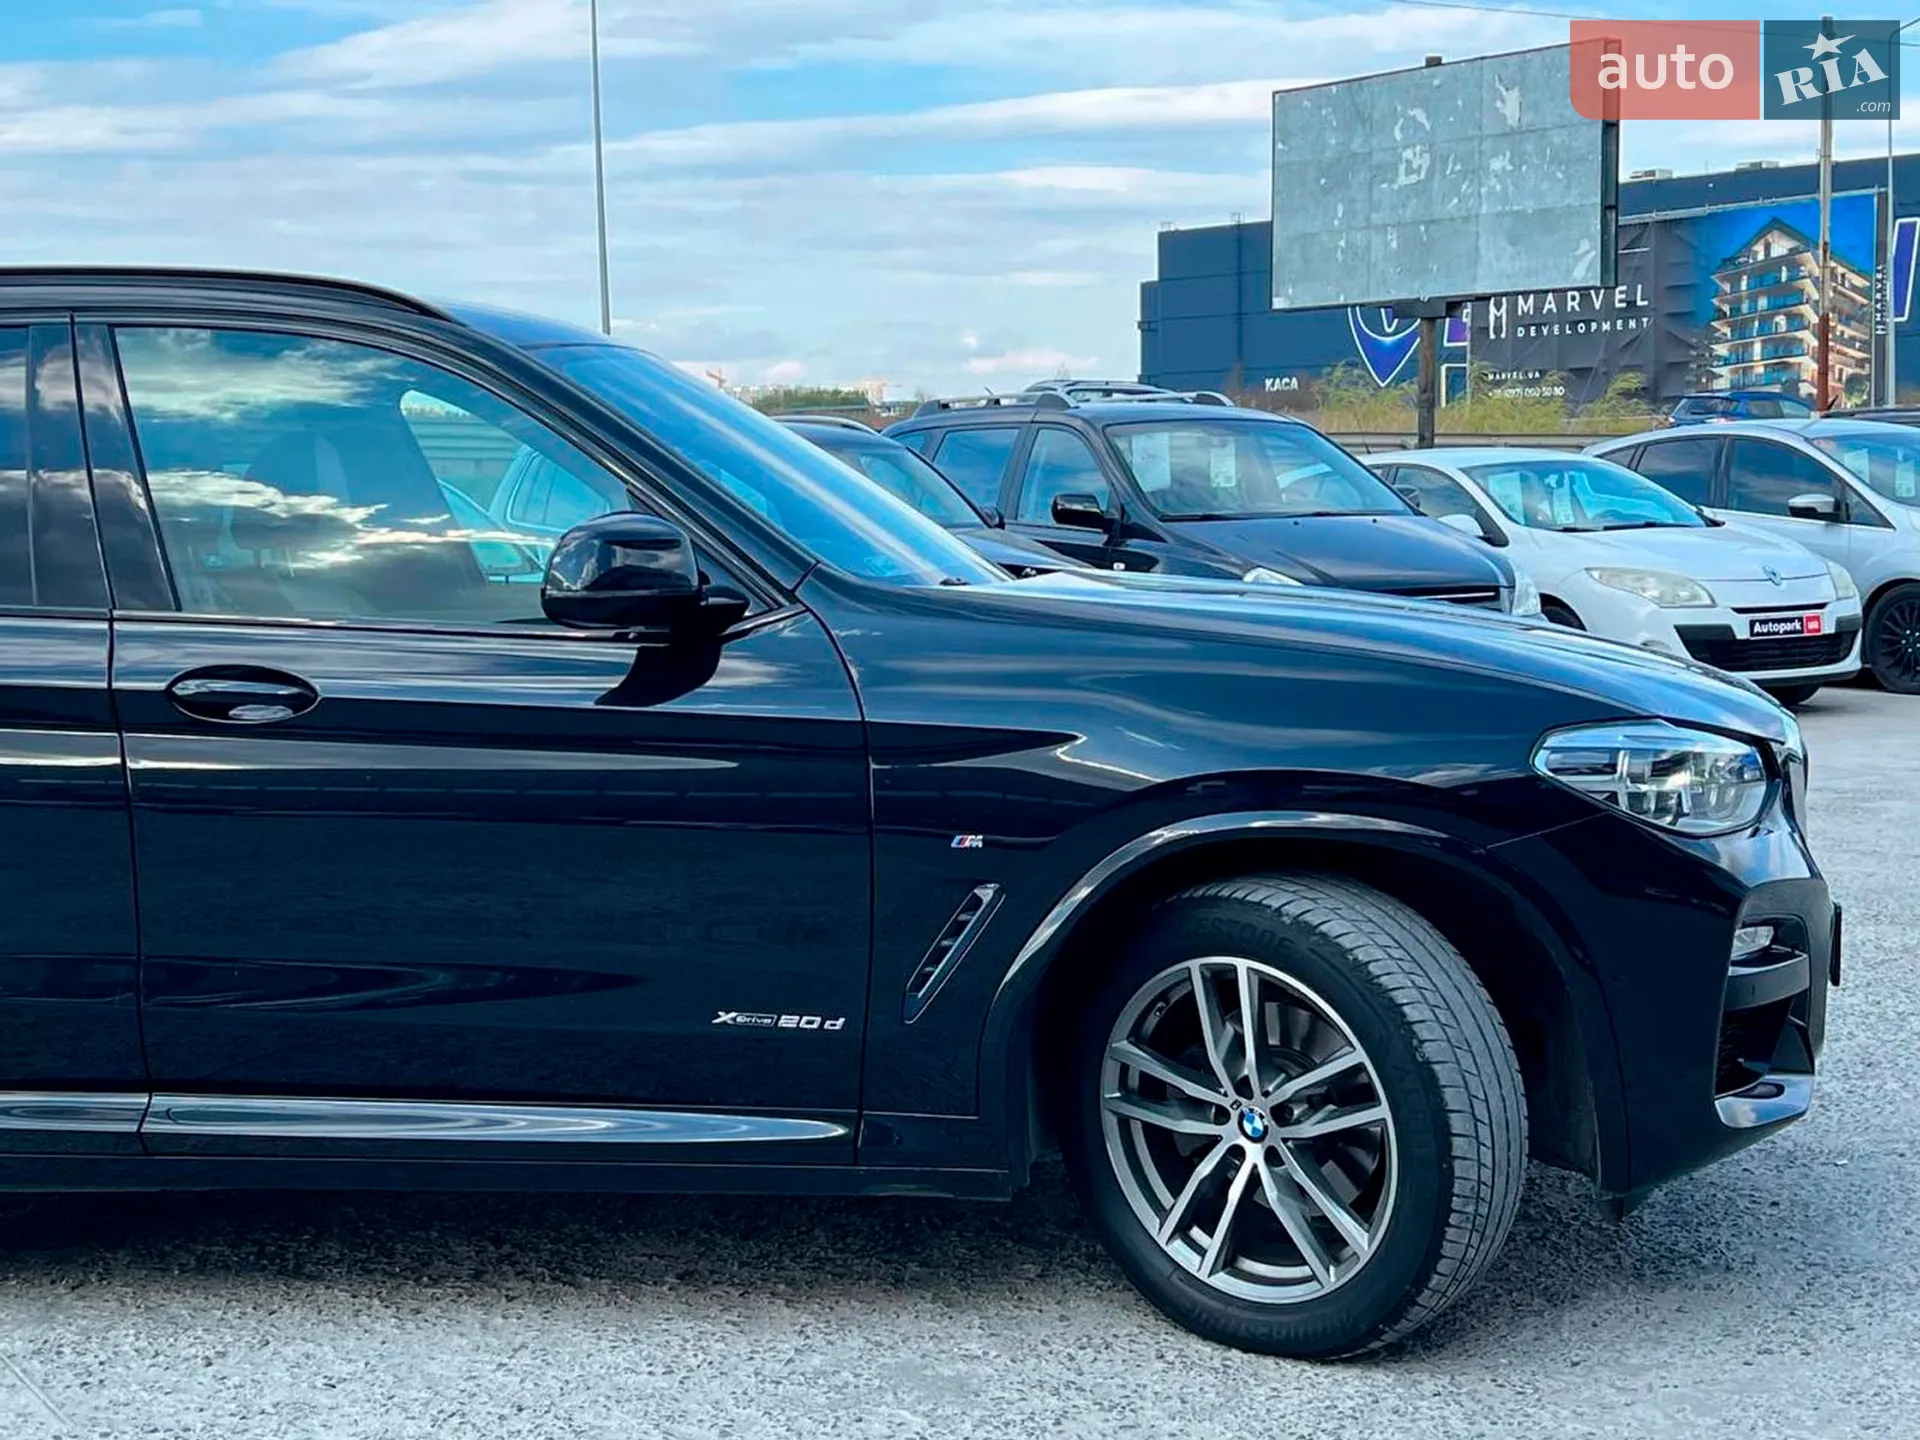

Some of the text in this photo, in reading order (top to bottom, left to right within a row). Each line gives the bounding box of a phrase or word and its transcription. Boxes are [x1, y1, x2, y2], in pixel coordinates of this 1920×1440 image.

[1517, 284, 1649, 317] MARVEL
[1517, 317, 1649, 337] DEVELOPMENT
[1754, 619, 1802, 634] Autopark
